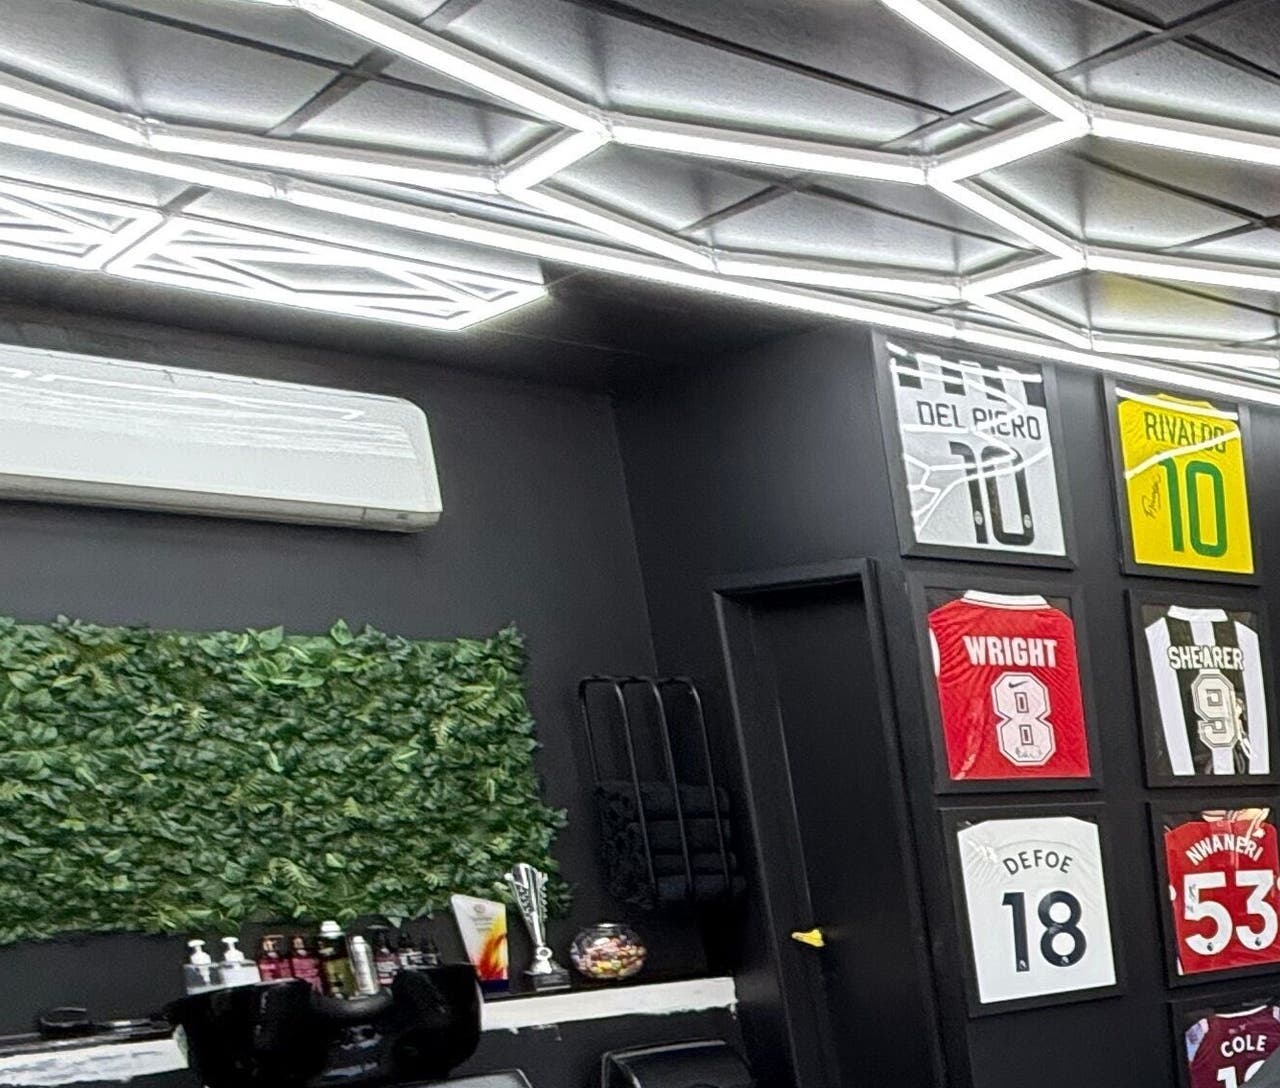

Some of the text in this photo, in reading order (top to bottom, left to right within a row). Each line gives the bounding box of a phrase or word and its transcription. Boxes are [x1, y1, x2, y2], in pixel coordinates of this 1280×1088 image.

[917, 400, 967, 428] DEL
[1144, 411, 1227, 454] RIVALDO
[949, 441, 1035, 546] 10
[1157, 455, 1229, 558] 10
[962, 635, 1058, 668] WRIGHT
[1167, 645, 1244, 670] SHEARER
[990, 671, 1056, 767] 8
[1191, 672, 1241, 749] 9
[1002, 849, 1073, 876] DEFOE
[1185, 833, 1264, 866] NWANERI
[1001, 890, 1087, 973] 18
[1183, 869, 1279, 956] 53
[1220, 1034, 1268, 1058] COLE
